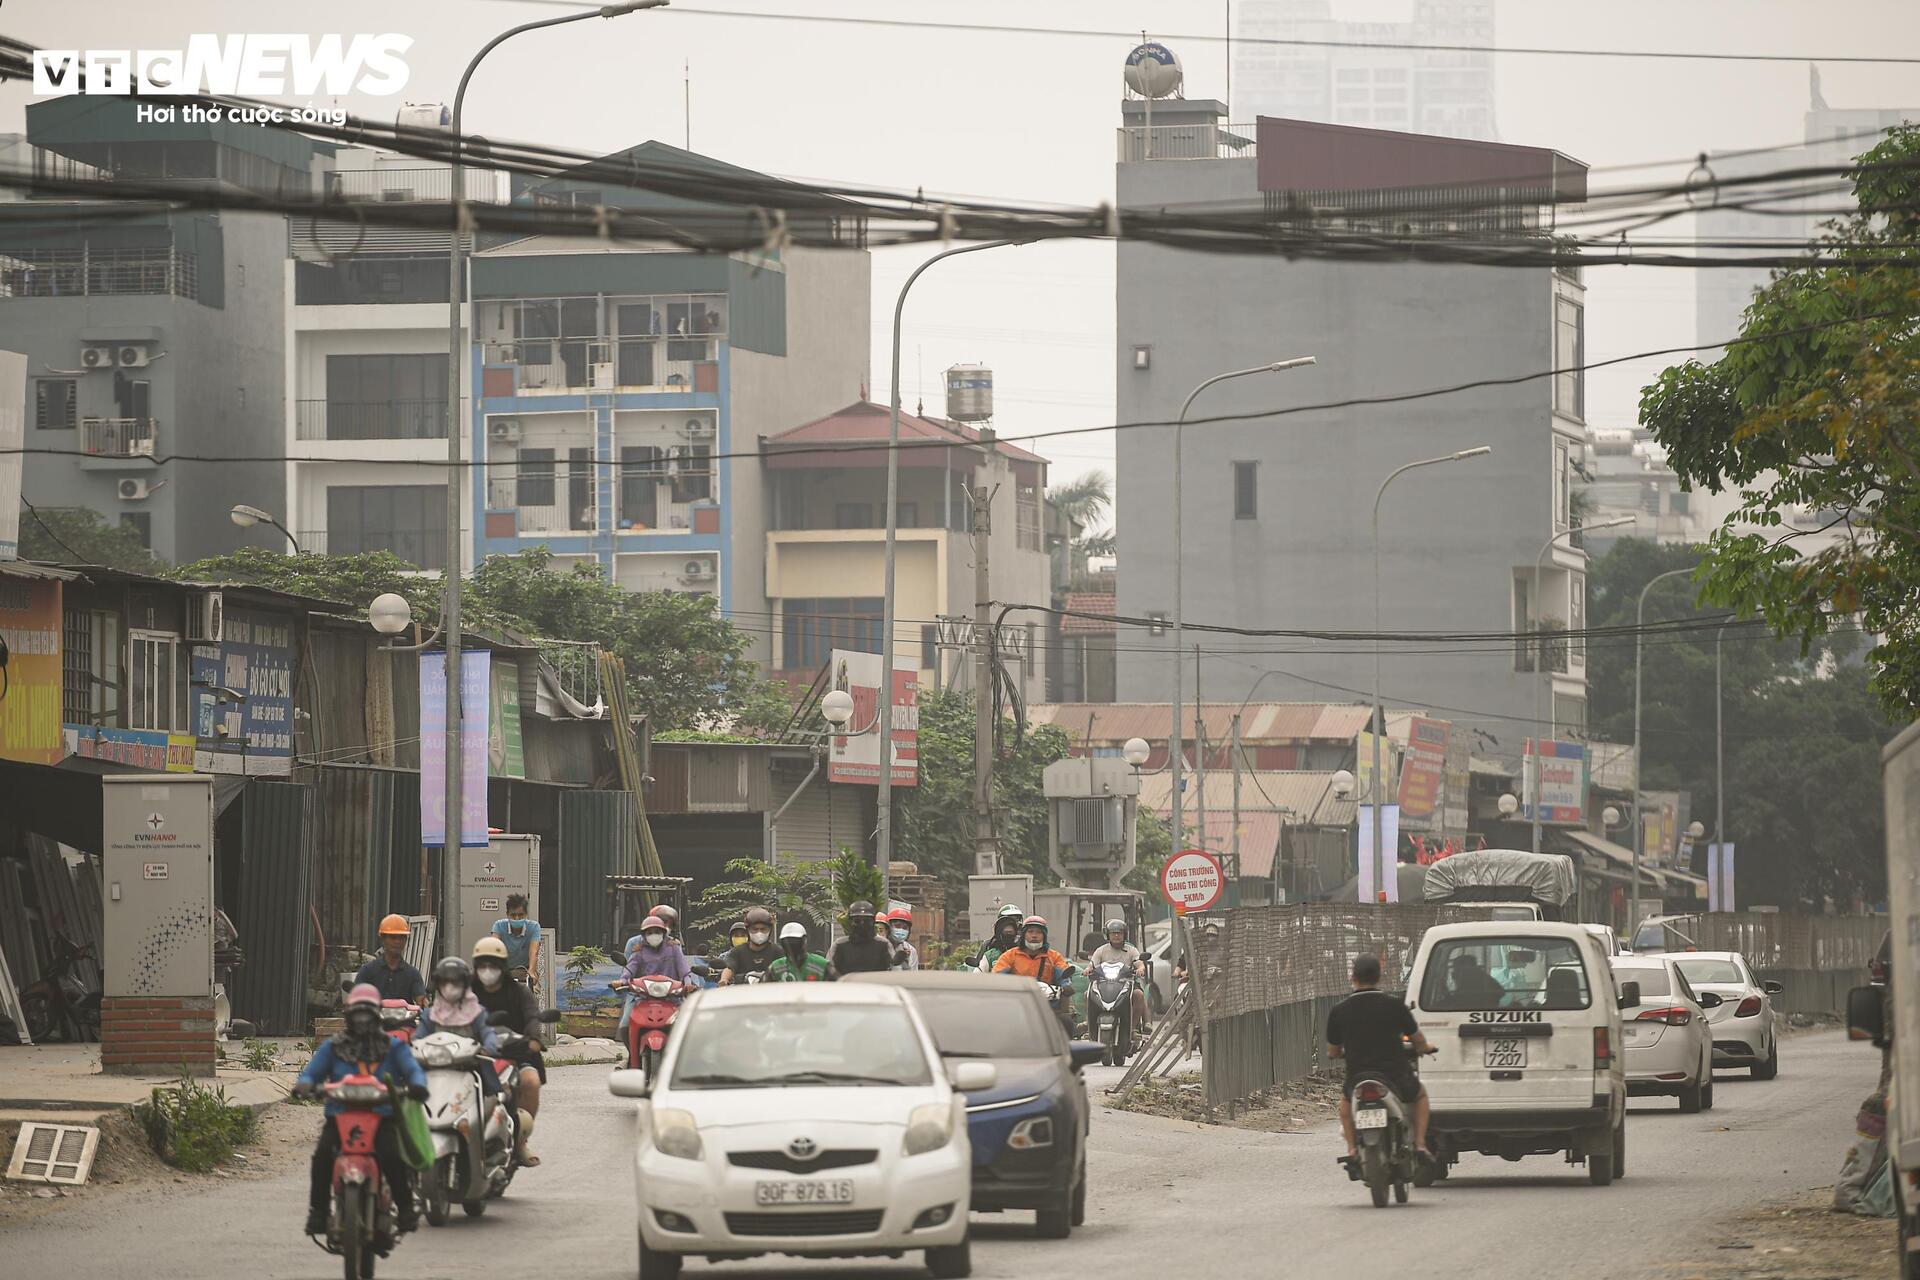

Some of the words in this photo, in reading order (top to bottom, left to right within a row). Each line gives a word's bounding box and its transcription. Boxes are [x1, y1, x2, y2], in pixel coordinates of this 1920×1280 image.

[134, 834, 177, 842] EVNHANOI
[1169, 867, 1188, 878] CÔNG
[1189, 864, 1214, 877] TRƯỜNG
[1168, 881, 1187, 891] ĐANG
[1188, 880, 1198, 890] THI
[1199, 877, 1217, 888] CÔNG
[1183, 892, 1205, 902] 5KM/h
[1469, 1012, 1542, 1023] SUZUKI
[1489, 1053, 1522, 1066] 7207
